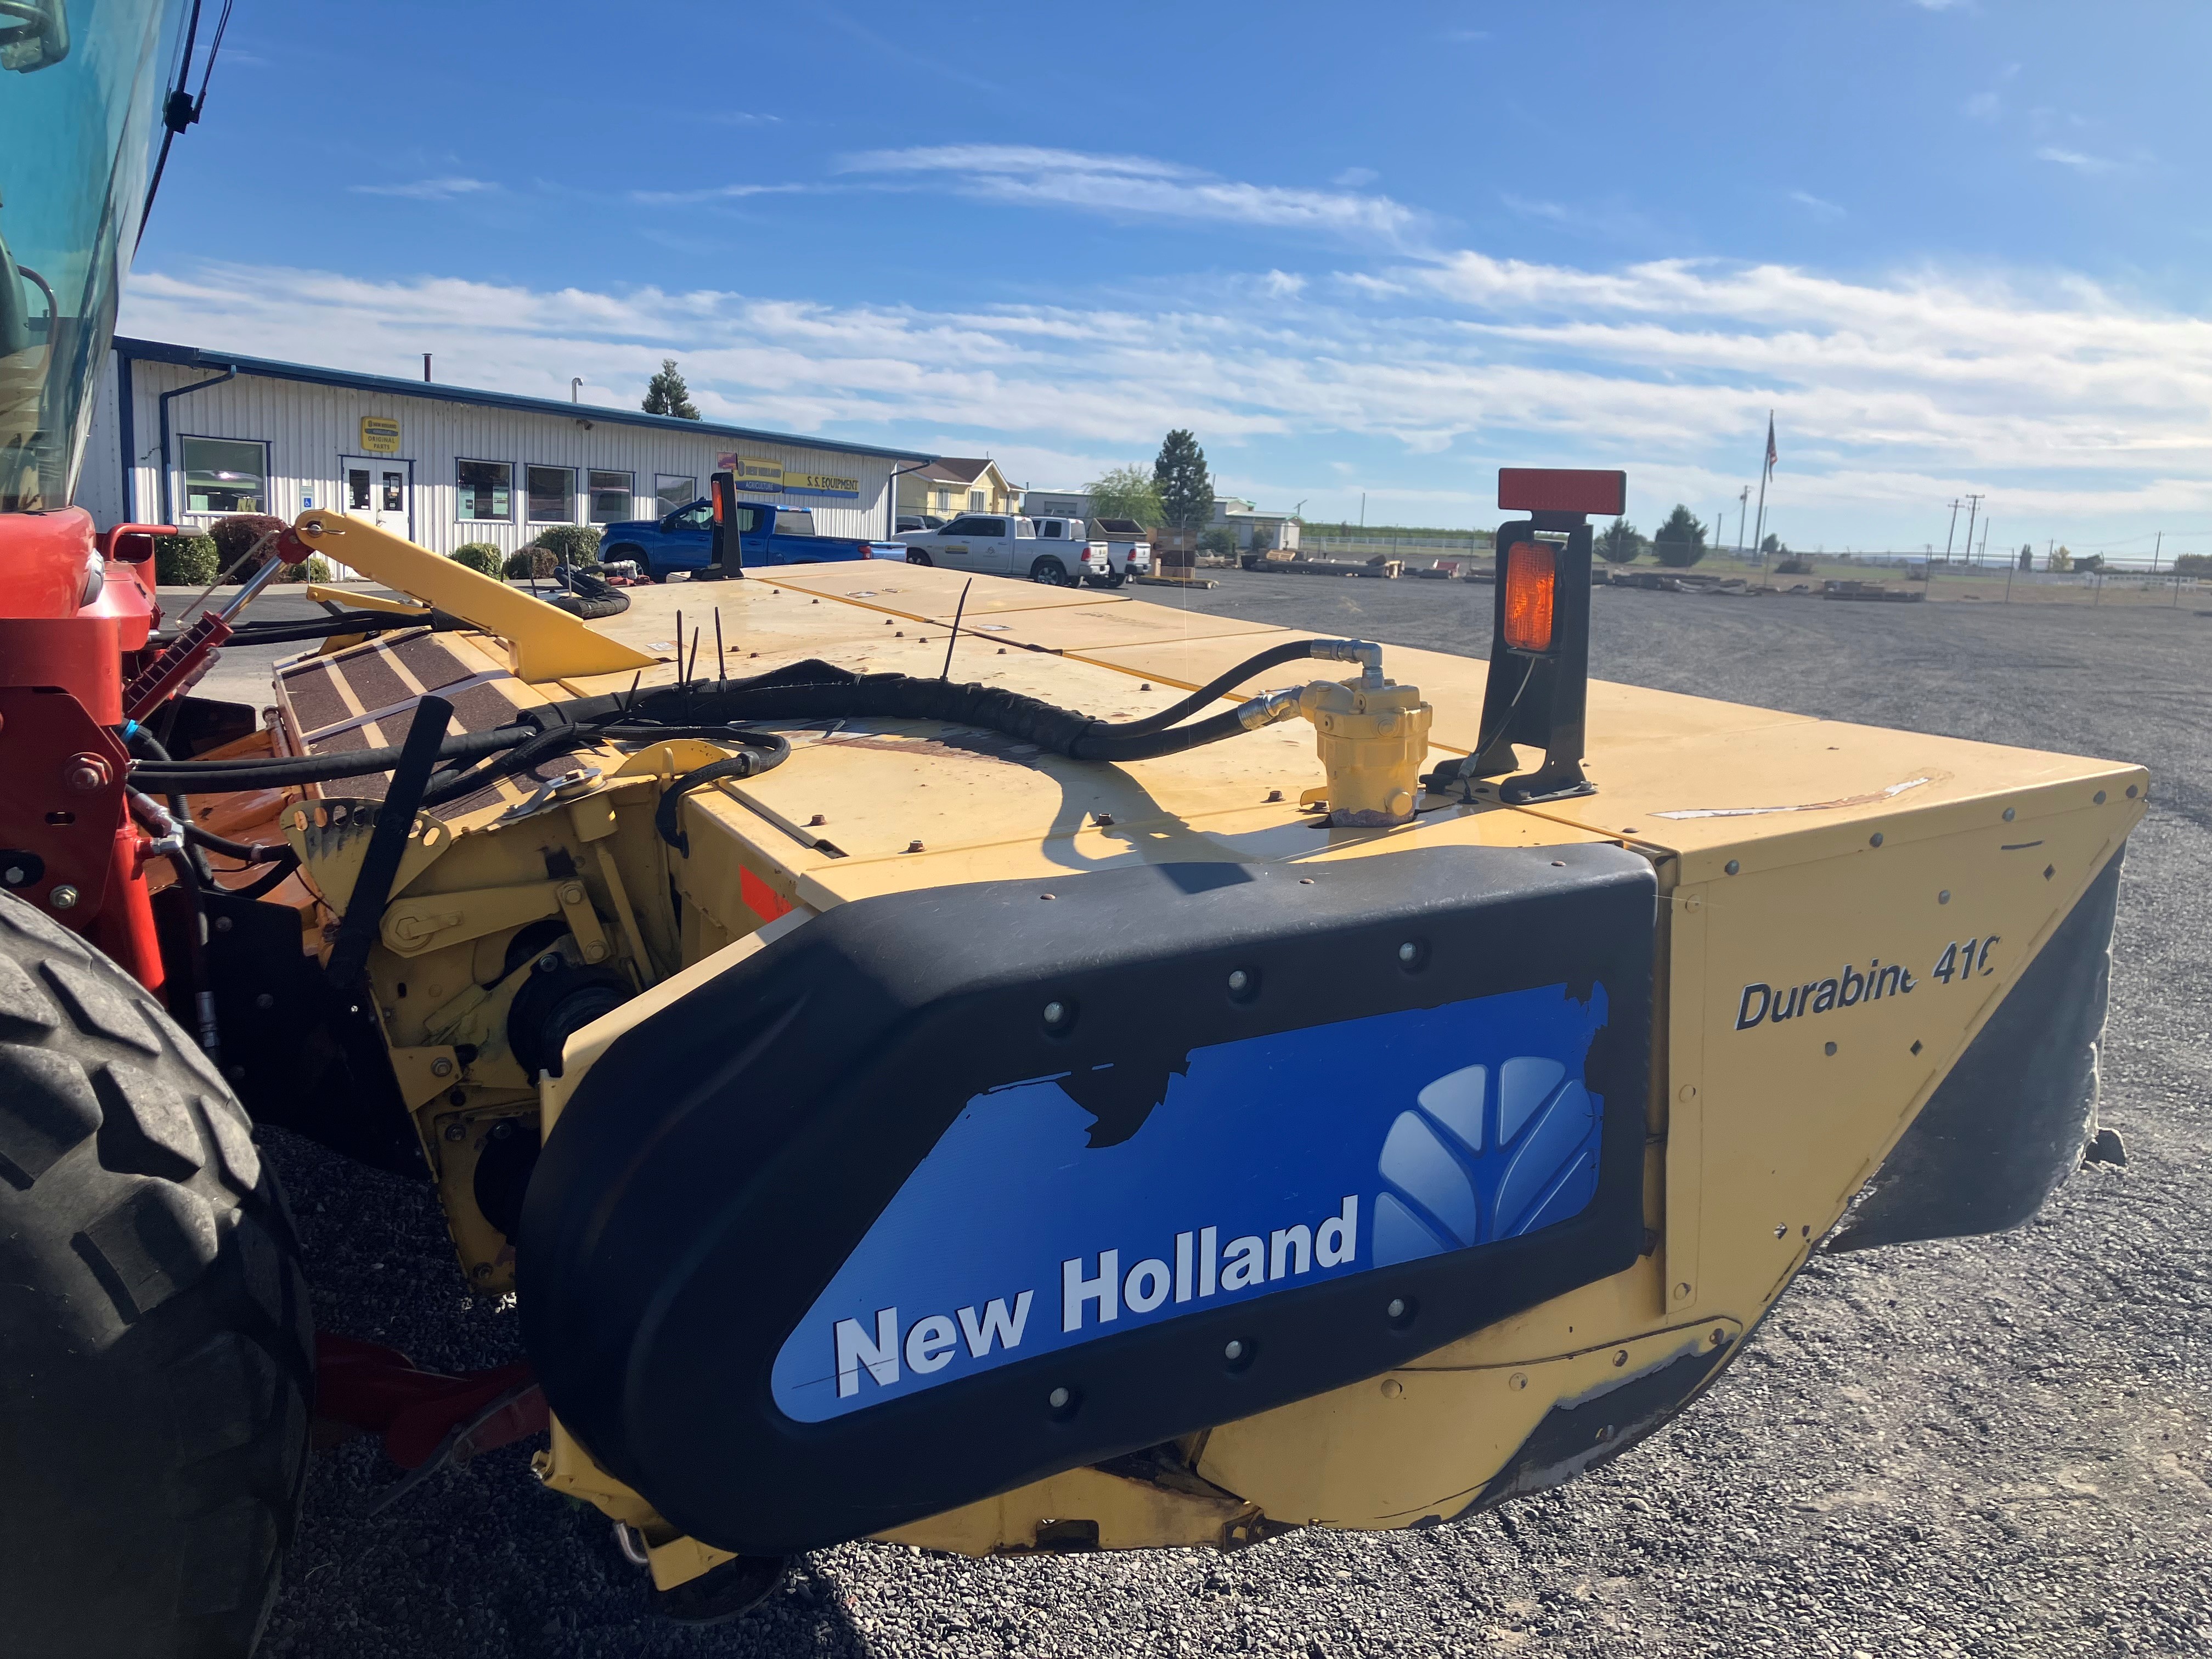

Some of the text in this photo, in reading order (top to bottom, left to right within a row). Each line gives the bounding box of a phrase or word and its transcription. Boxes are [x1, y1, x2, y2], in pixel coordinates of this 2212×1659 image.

[745, 482, 774, 491] AGRICULTURE
[821, 477, 859, 490] EQUIPMENT
[1734, 958, 1919, 1031] Durabine
[833, 1194, 1358, 1398] New Holland
